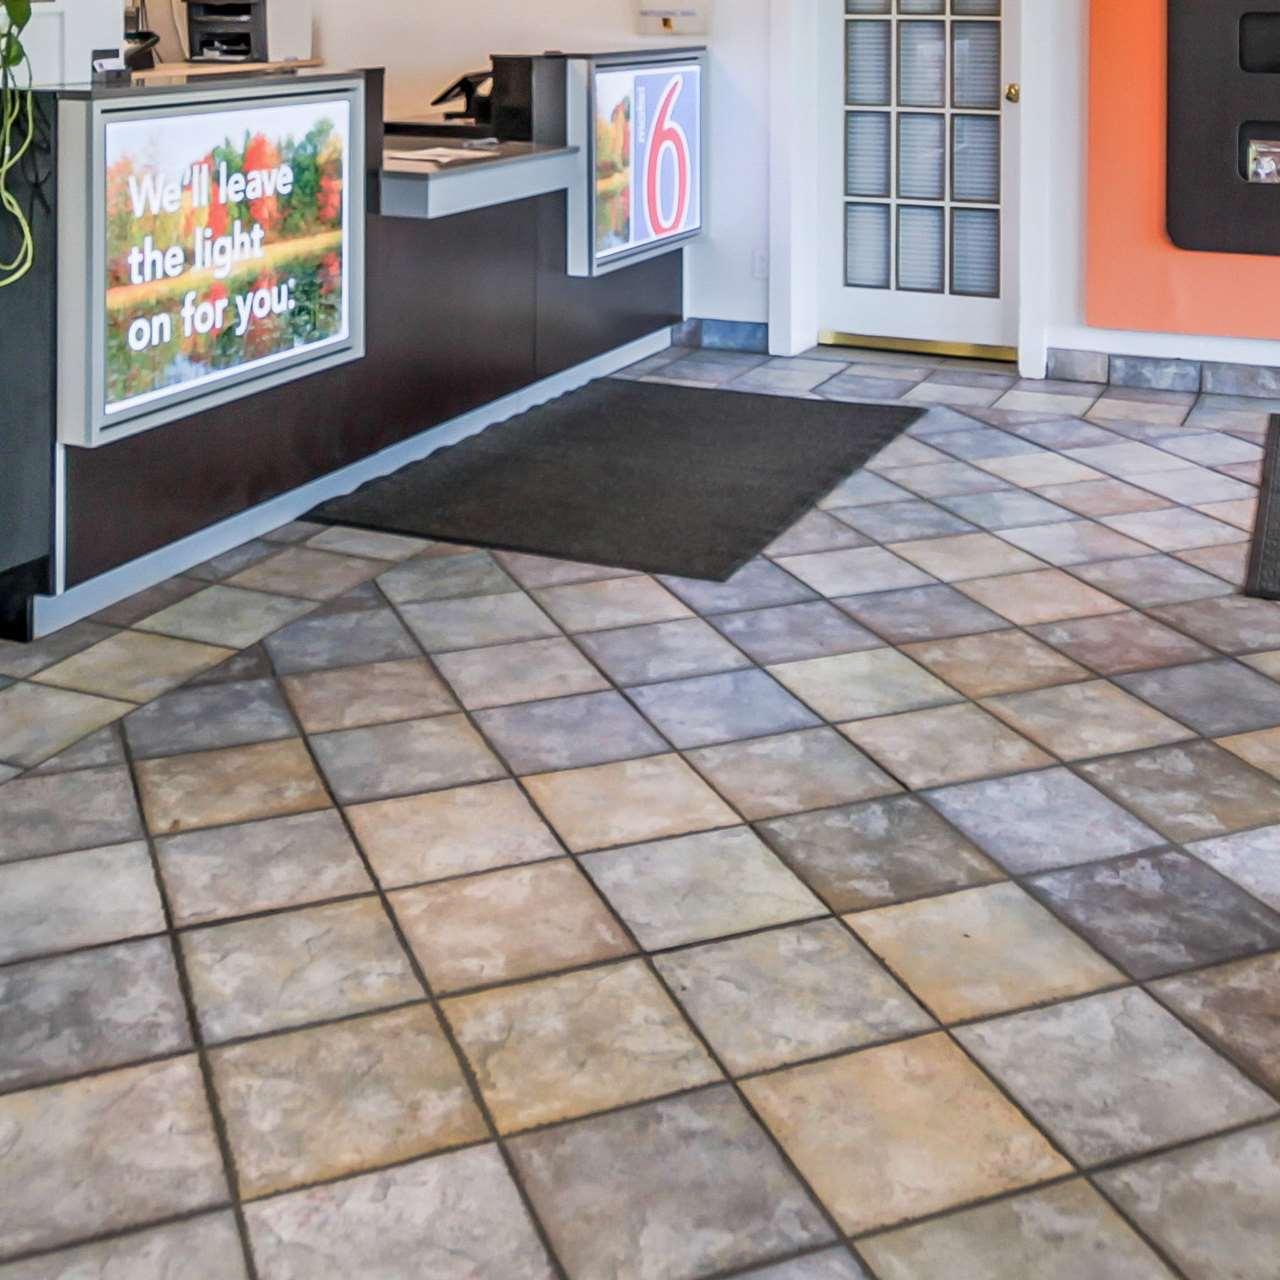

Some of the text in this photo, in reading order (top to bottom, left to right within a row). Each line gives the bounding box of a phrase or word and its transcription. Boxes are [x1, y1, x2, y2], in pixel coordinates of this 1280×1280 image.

[643, 73, 691, 238] 6
[128, 161, 295, 218] We'll leave
[128, 219, 265, 285] the light
[128, 311, 171, 351] on
[181, 290, 228, 337] for
